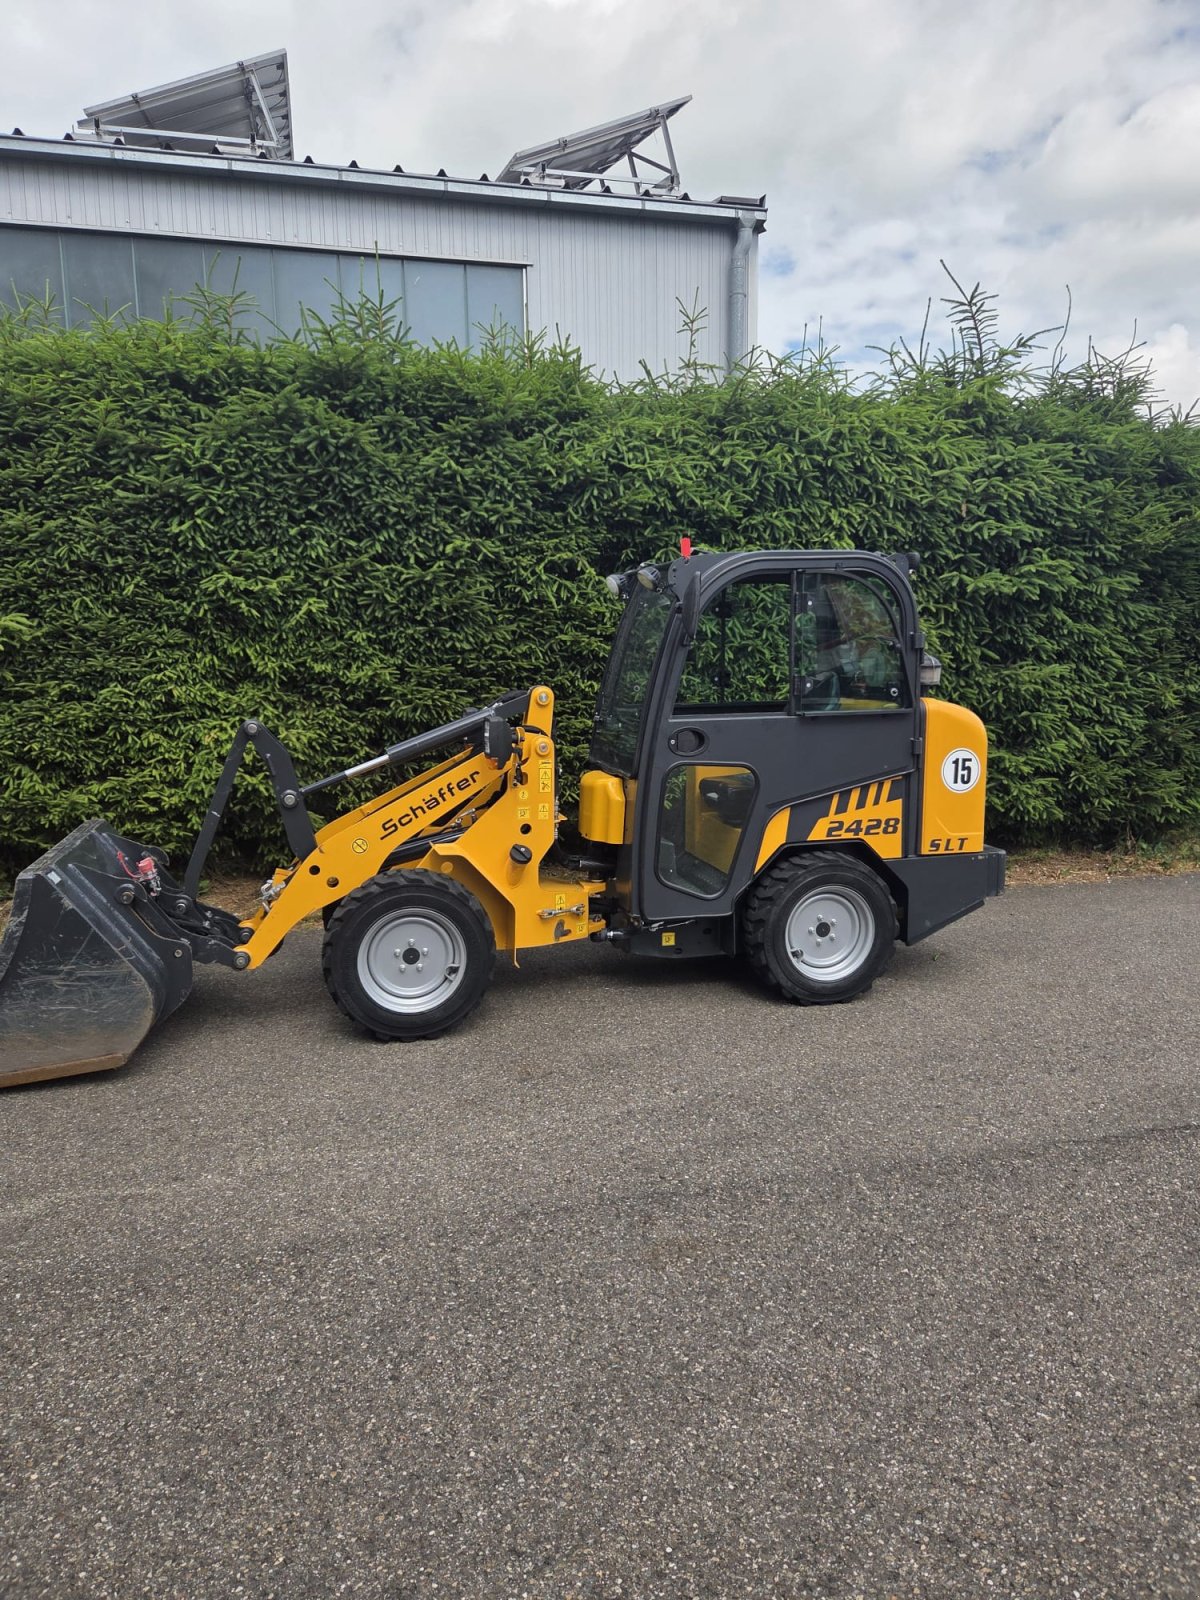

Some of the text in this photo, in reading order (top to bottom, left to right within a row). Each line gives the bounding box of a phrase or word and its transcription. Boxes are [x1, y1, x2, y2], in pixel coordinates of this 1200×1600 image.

[952, 758, 972, 785] 15
[380, 770, 480, 840] Schäffer
[826, 818, 900, 838] 2428
[928, 837, 969, 852] SLT
